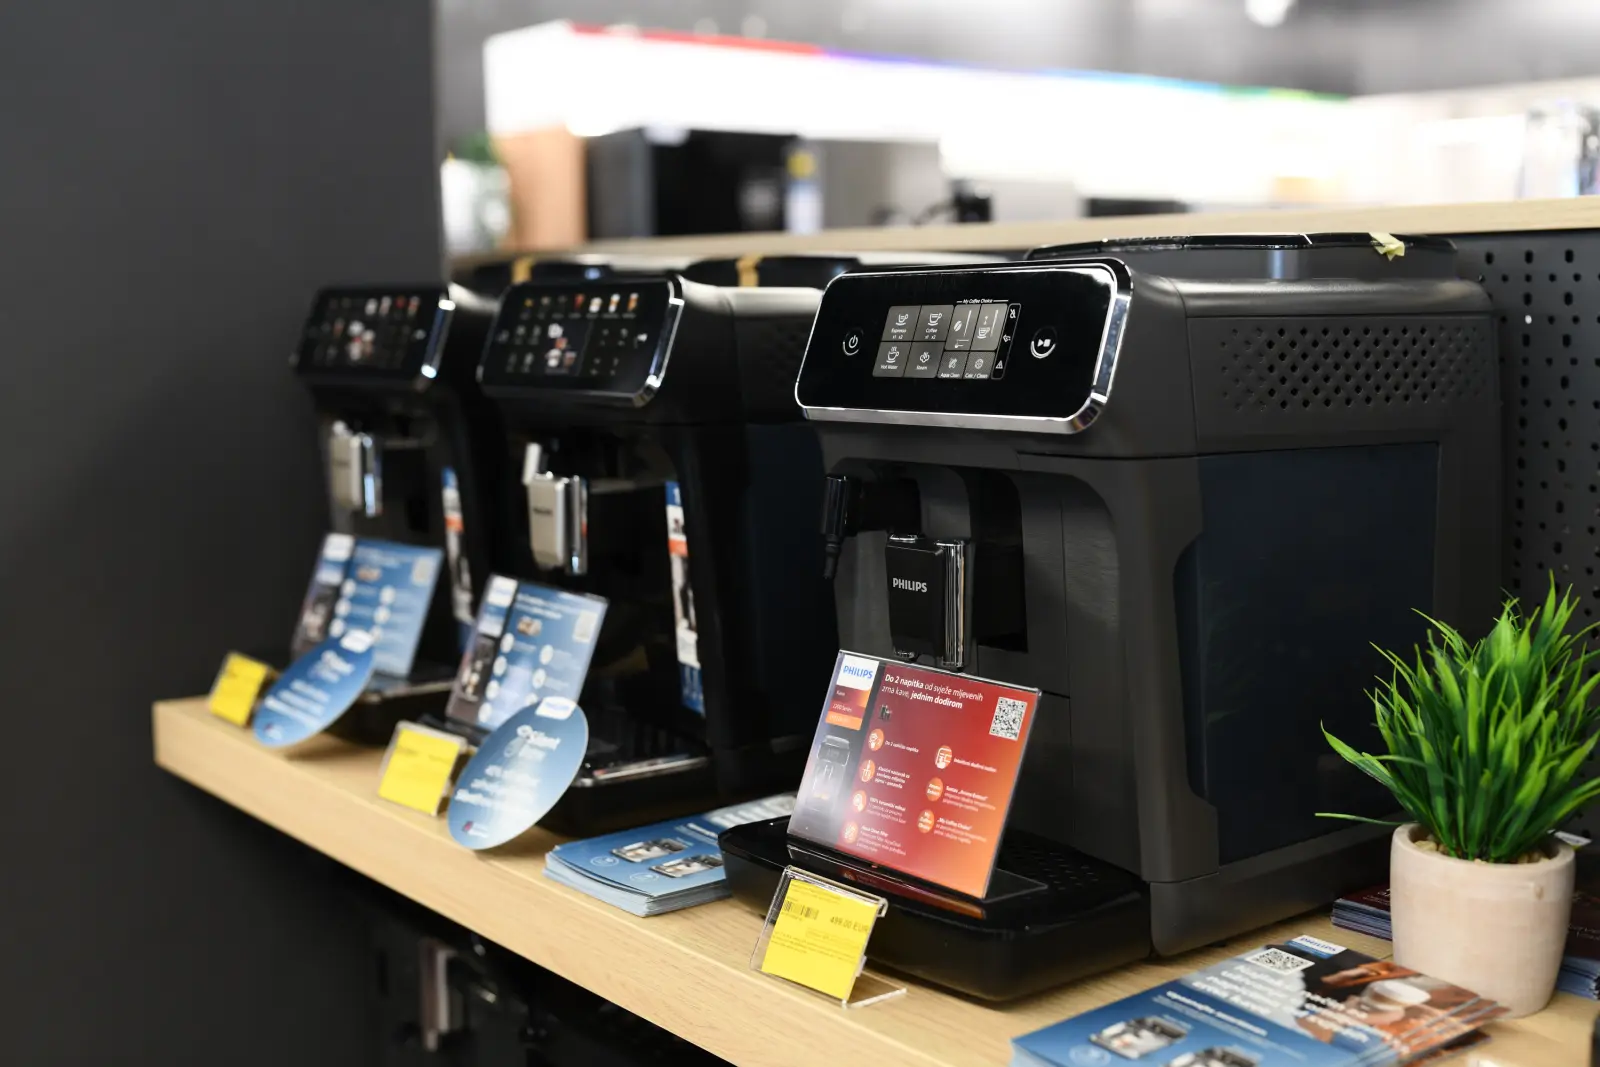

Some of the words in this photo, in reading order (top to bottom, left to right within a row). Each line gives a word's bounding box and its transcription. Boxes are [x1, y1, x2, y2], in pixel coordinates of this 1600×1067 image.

[893, 577, 927, 593] PHILIPS
[843, 666, 873, 679] PHILIPS
[885, 674, 894, 683] Do
[900, 678, 924, 689] napitka
[925, 682, 932, 690] od
[933, 684, 952, 695] svježe
[952, 689, 983, 702] mljevenih
[895, 688, 910, 697] kave,
[910, 691, 934, 702] jednim
[934, 696, 962, 709] dodirom
[853, 921, 868, 932] EUR
